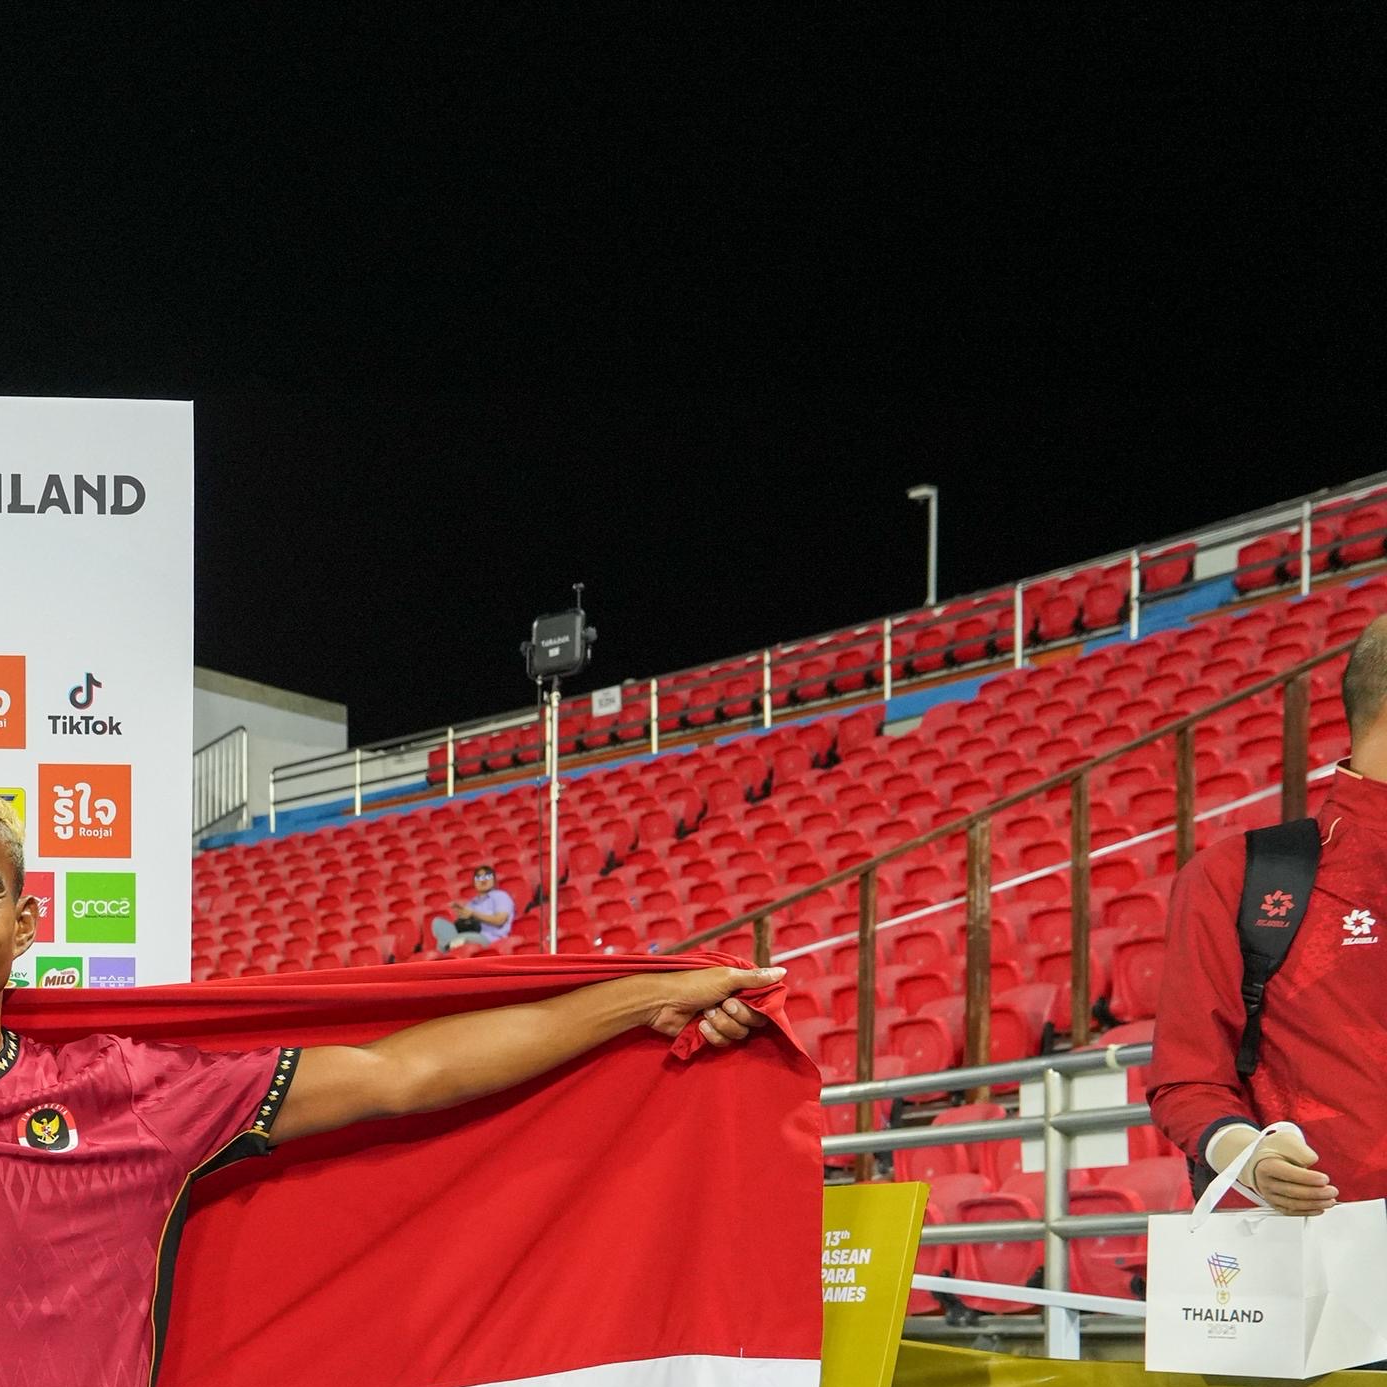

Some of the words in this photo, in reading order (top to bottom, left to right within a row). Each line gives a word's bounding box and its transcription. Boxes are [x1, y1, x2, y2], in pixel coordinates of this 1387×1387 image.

[48, 715, 122, 736] TikTok
[79, 827, 113, 839] Roojai
[44, 974, 76, 986] MILO
[825, 1230, 850, 1246] 13th
[822, 1248, 872, 1265] ASEAN
[822, 1286, 867, 1302] AMES
[1182, 1307, 1264, 1323] THAILAND
